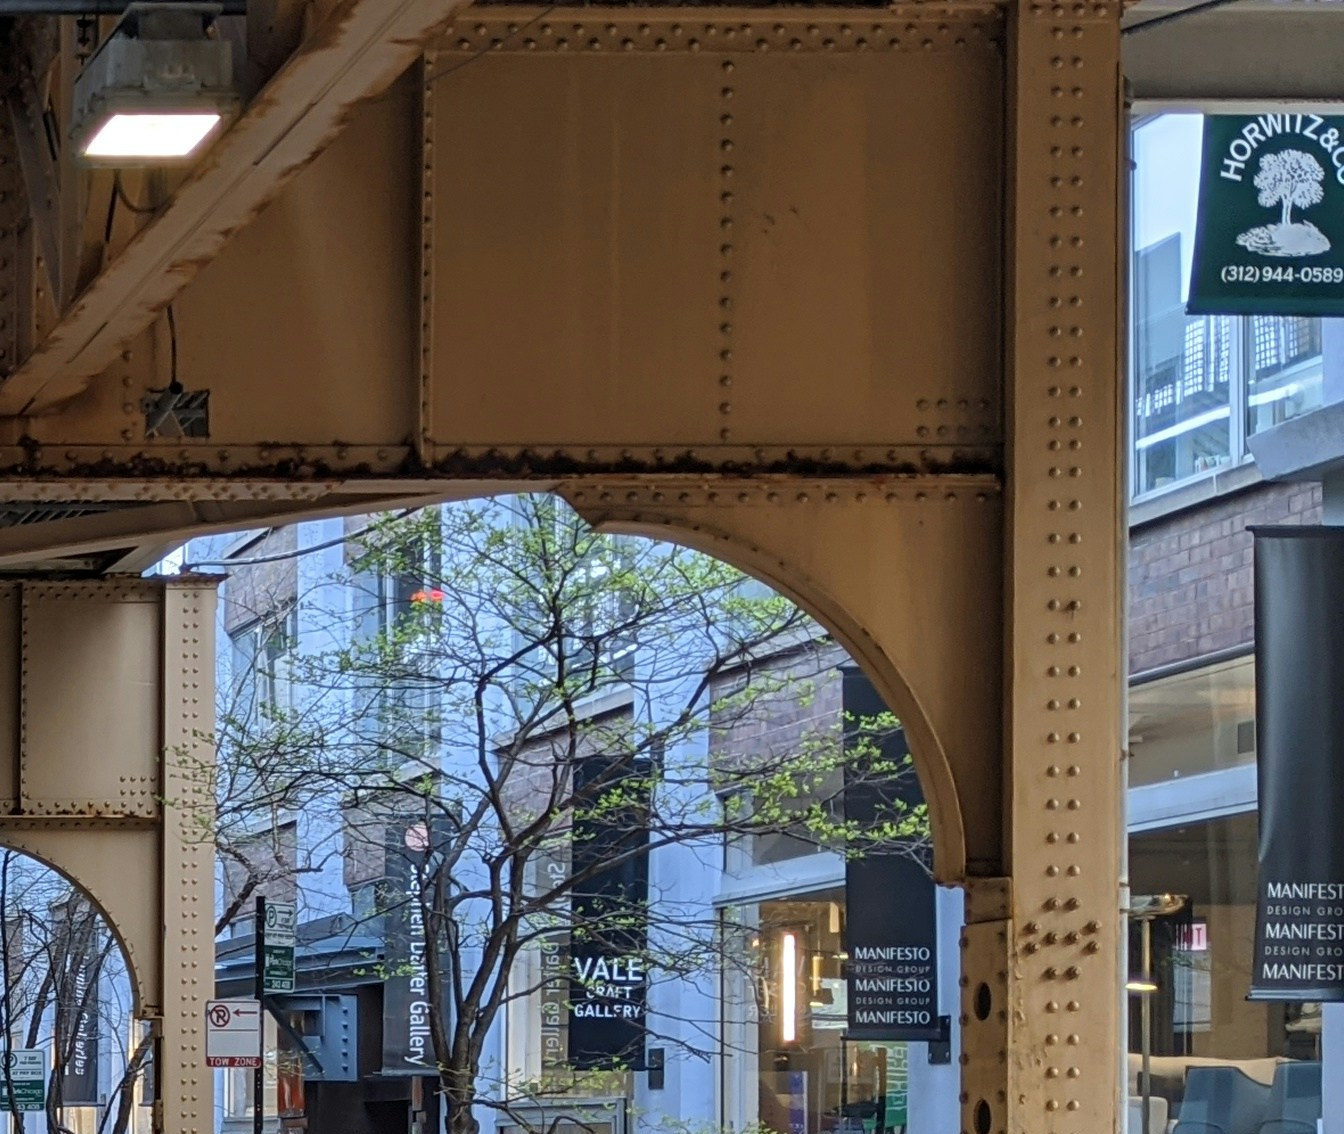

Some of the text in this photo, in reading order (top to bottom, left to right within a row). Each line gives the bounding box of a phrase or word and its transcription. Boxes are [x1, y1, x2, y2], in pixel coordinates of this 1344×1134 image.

[1266, 905, 1311, 916] DESIGN
[854, 946, 931, 961] MANIFESTO
[1264, 945, 1310, 956] DESIGN
[574, 956, 644, 982] VALE
[855, 965, 931, 974] DESIGN GROUP
[854, 978, 931, 993] MANIFESTO
[855, 996, 931, 1005] DESIGN GROUP
[573, 1003, 641, 1019] GALLERY
[854, 1010, 931, 1025] MANIFESTO
[404, 1000, 429, 1067] Gallery
[209, 1057, 258, 1067] TOW ZONE
